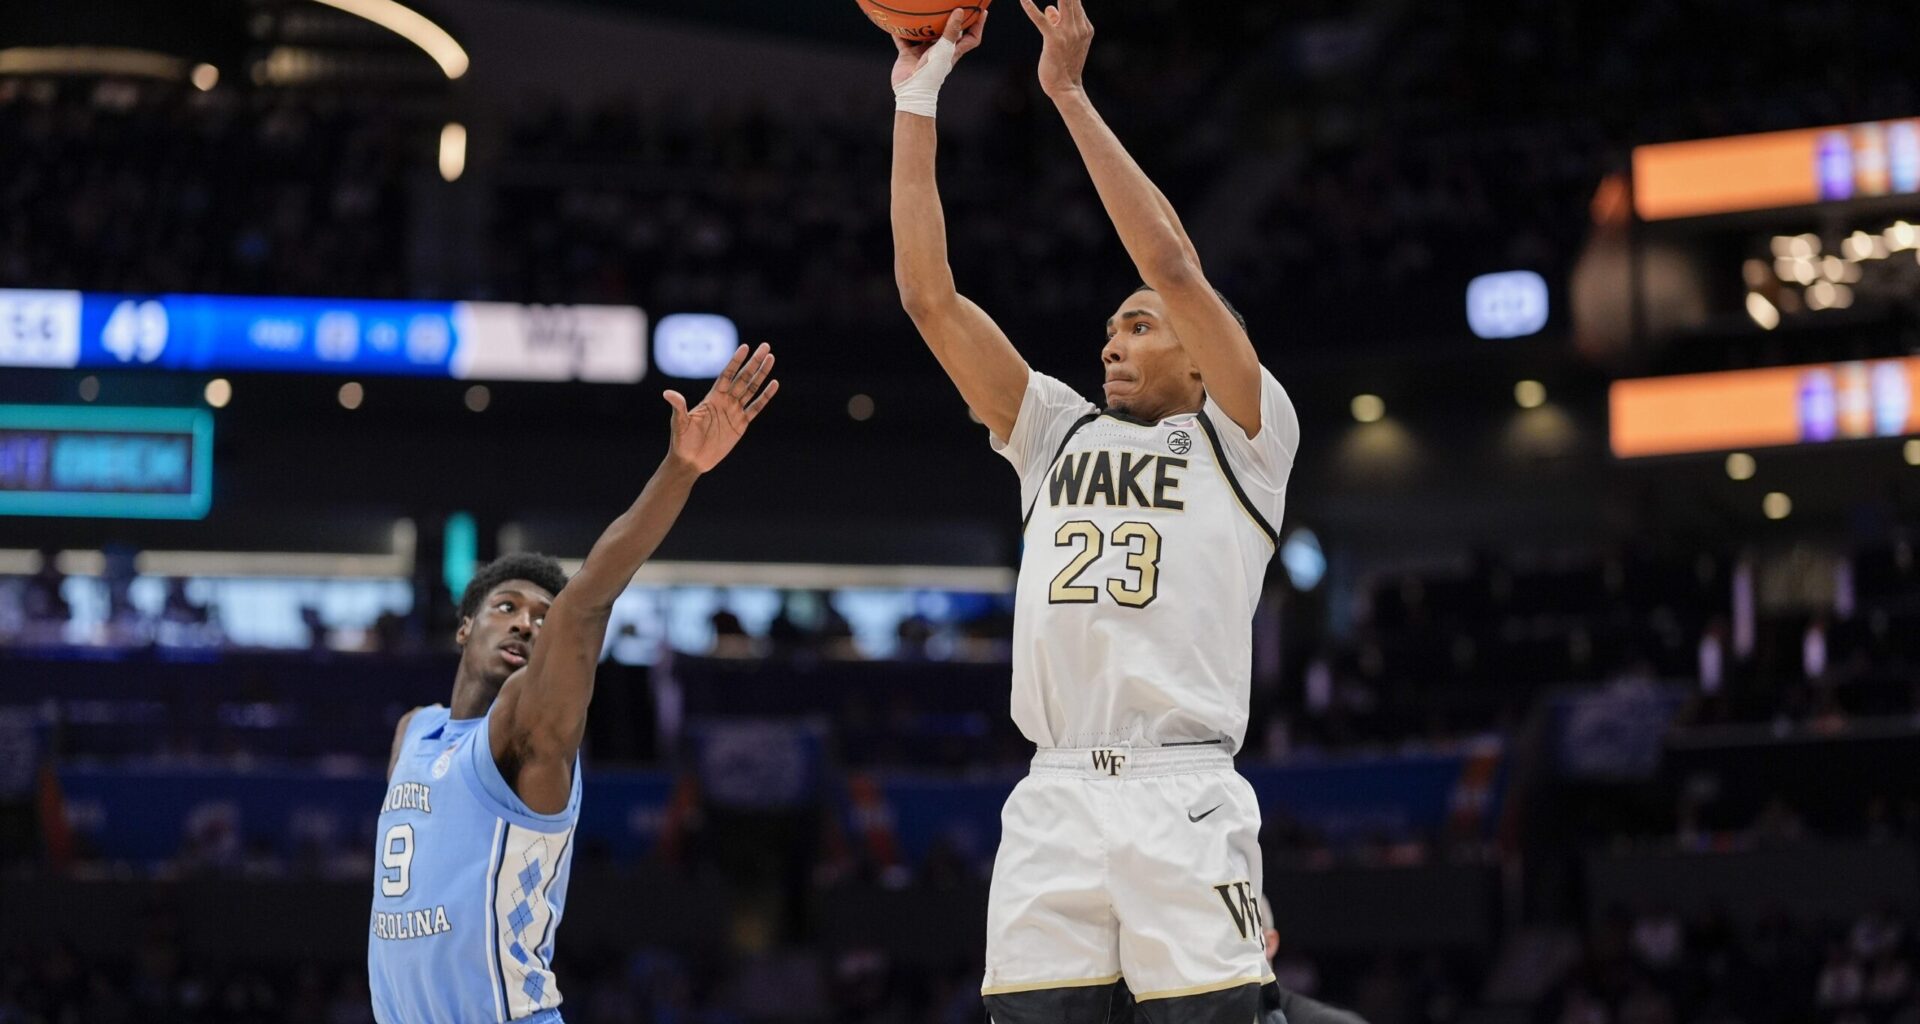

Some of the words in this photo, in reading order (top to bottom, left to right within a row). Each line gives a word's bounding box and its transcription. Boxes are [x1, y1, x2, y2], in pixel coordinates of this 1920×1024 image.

[1049, 450, 1188, 511] WAKE
[1048, 520, 1162, 609] 23
[1091, 749, 1126, 776] WF
[381, 822, 415, 898] 9
